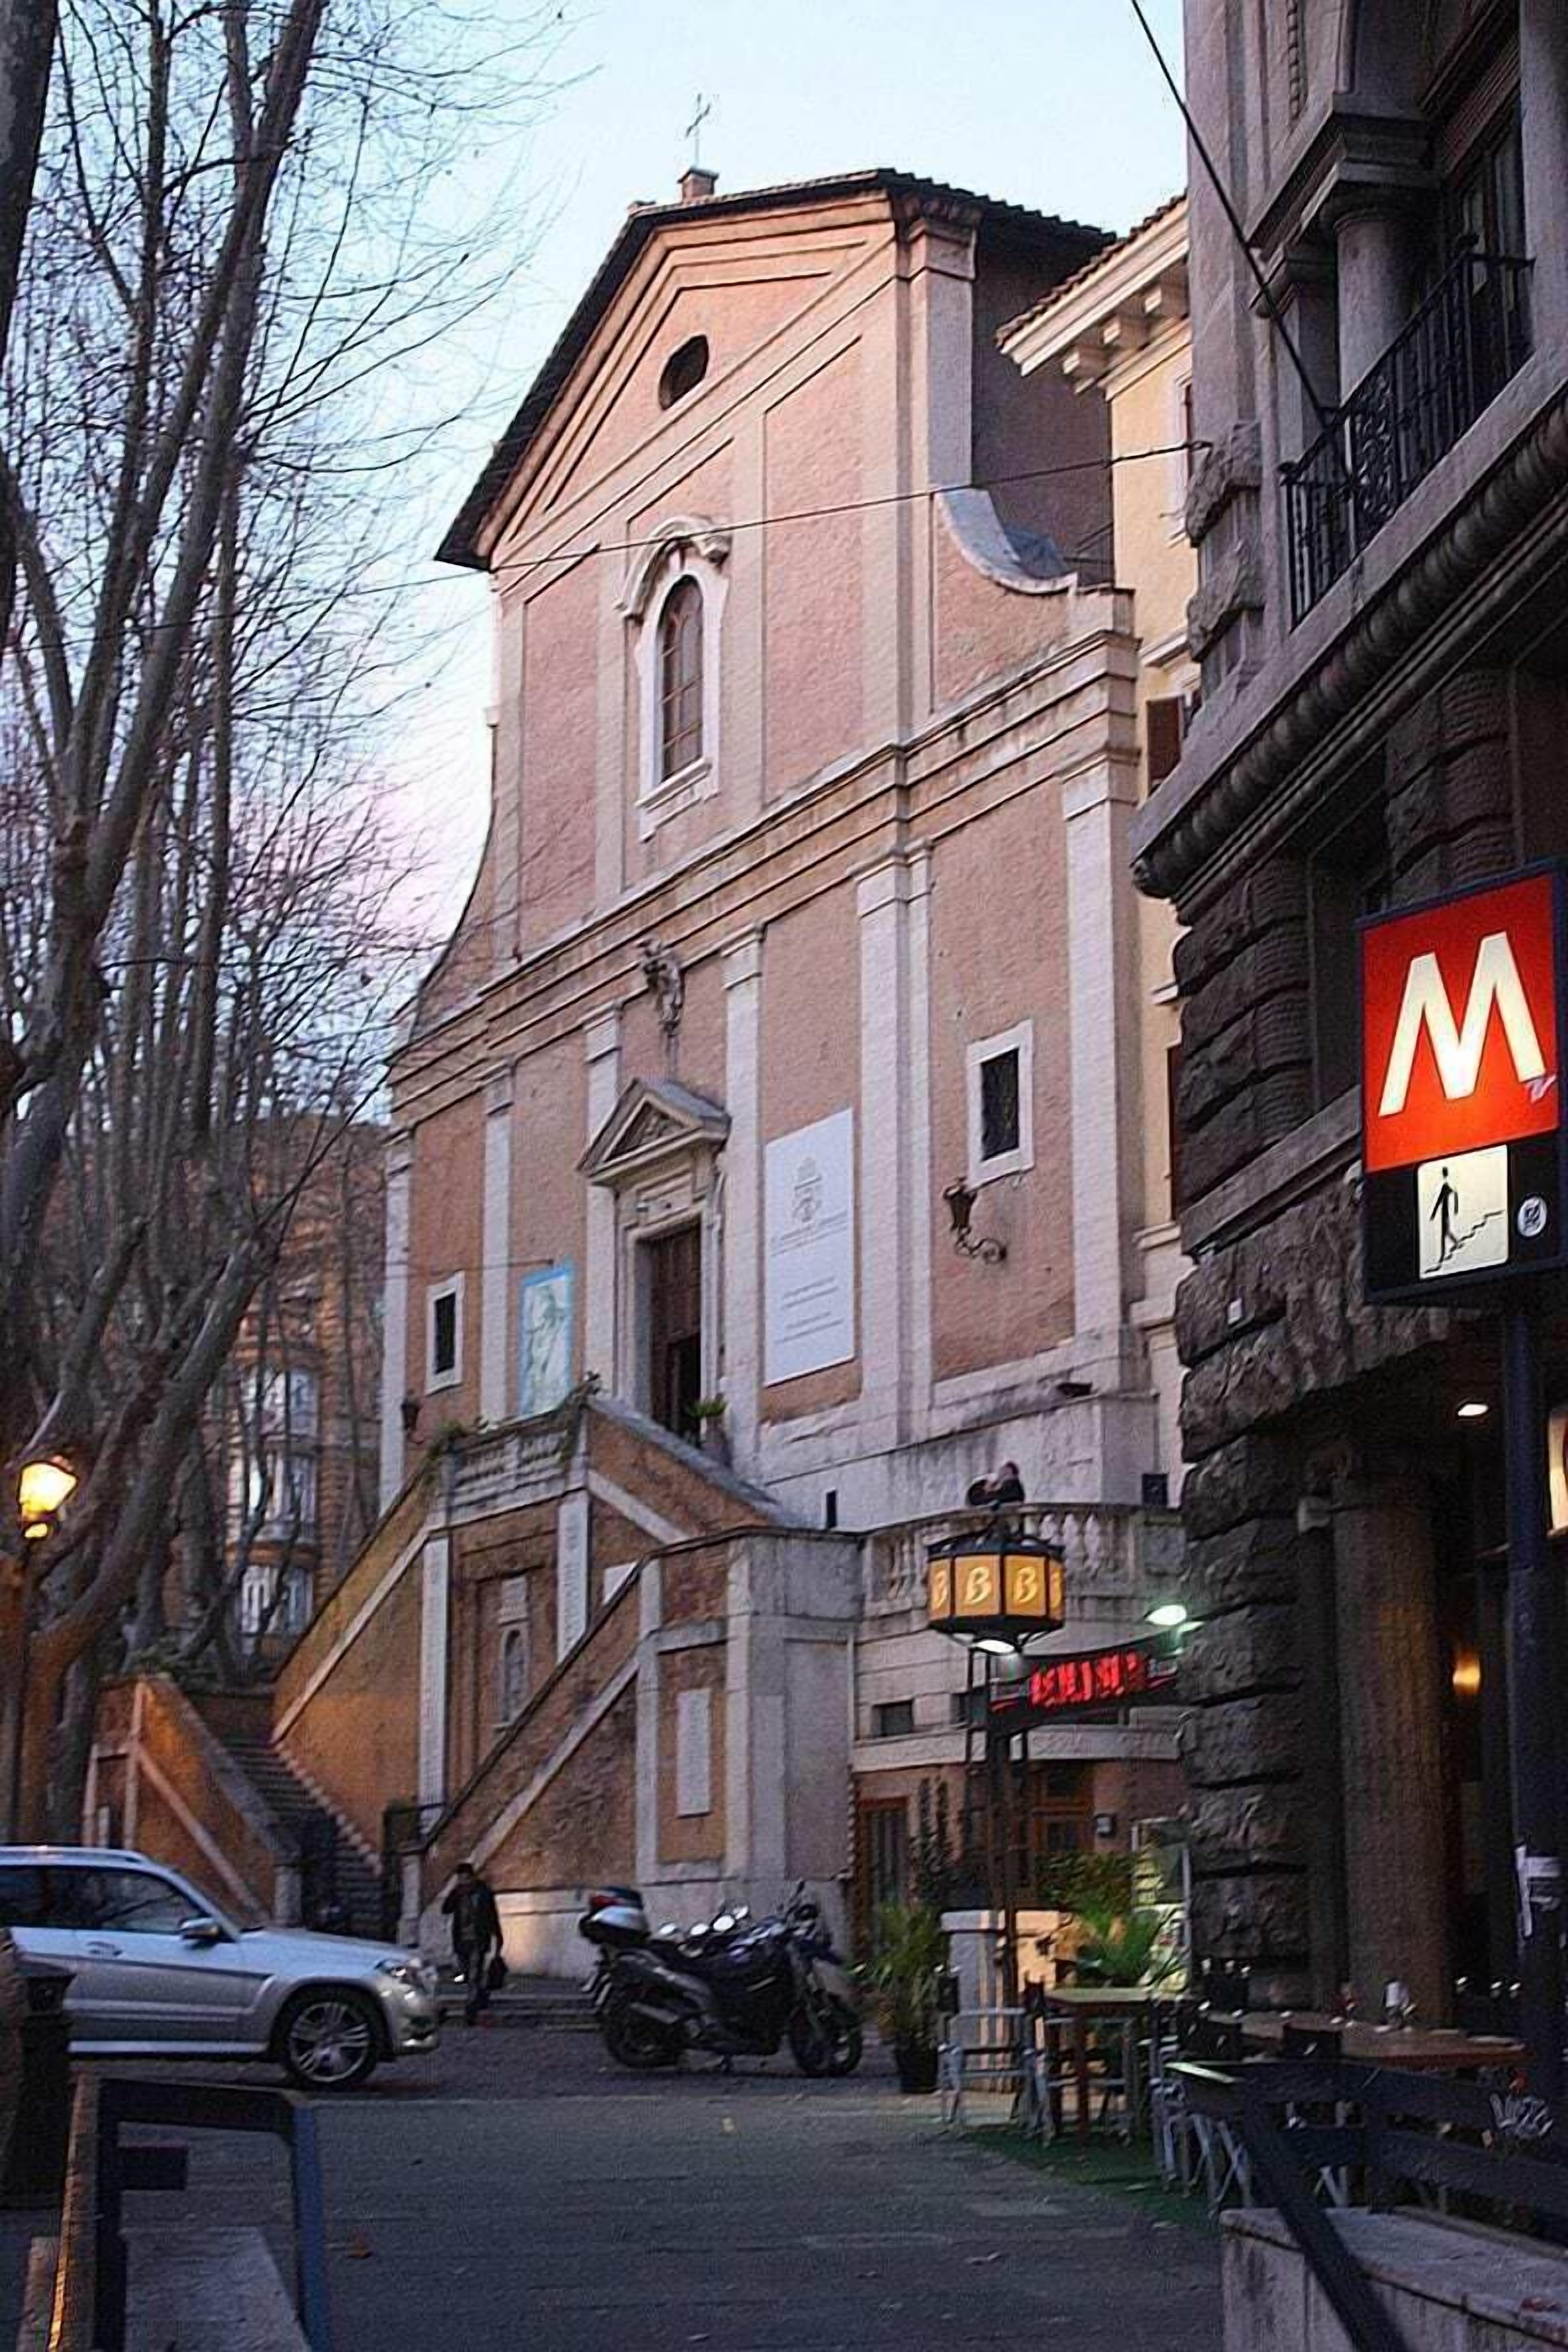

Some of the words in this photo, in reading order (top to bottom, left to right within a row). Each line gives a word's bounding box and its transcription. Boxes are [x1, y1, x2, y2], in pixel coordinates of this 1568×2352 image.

[1378, 931, 1546, 1117] M
[964, 1566, 992, 1604] B
[1013, 1566, 1037, 1603] B
